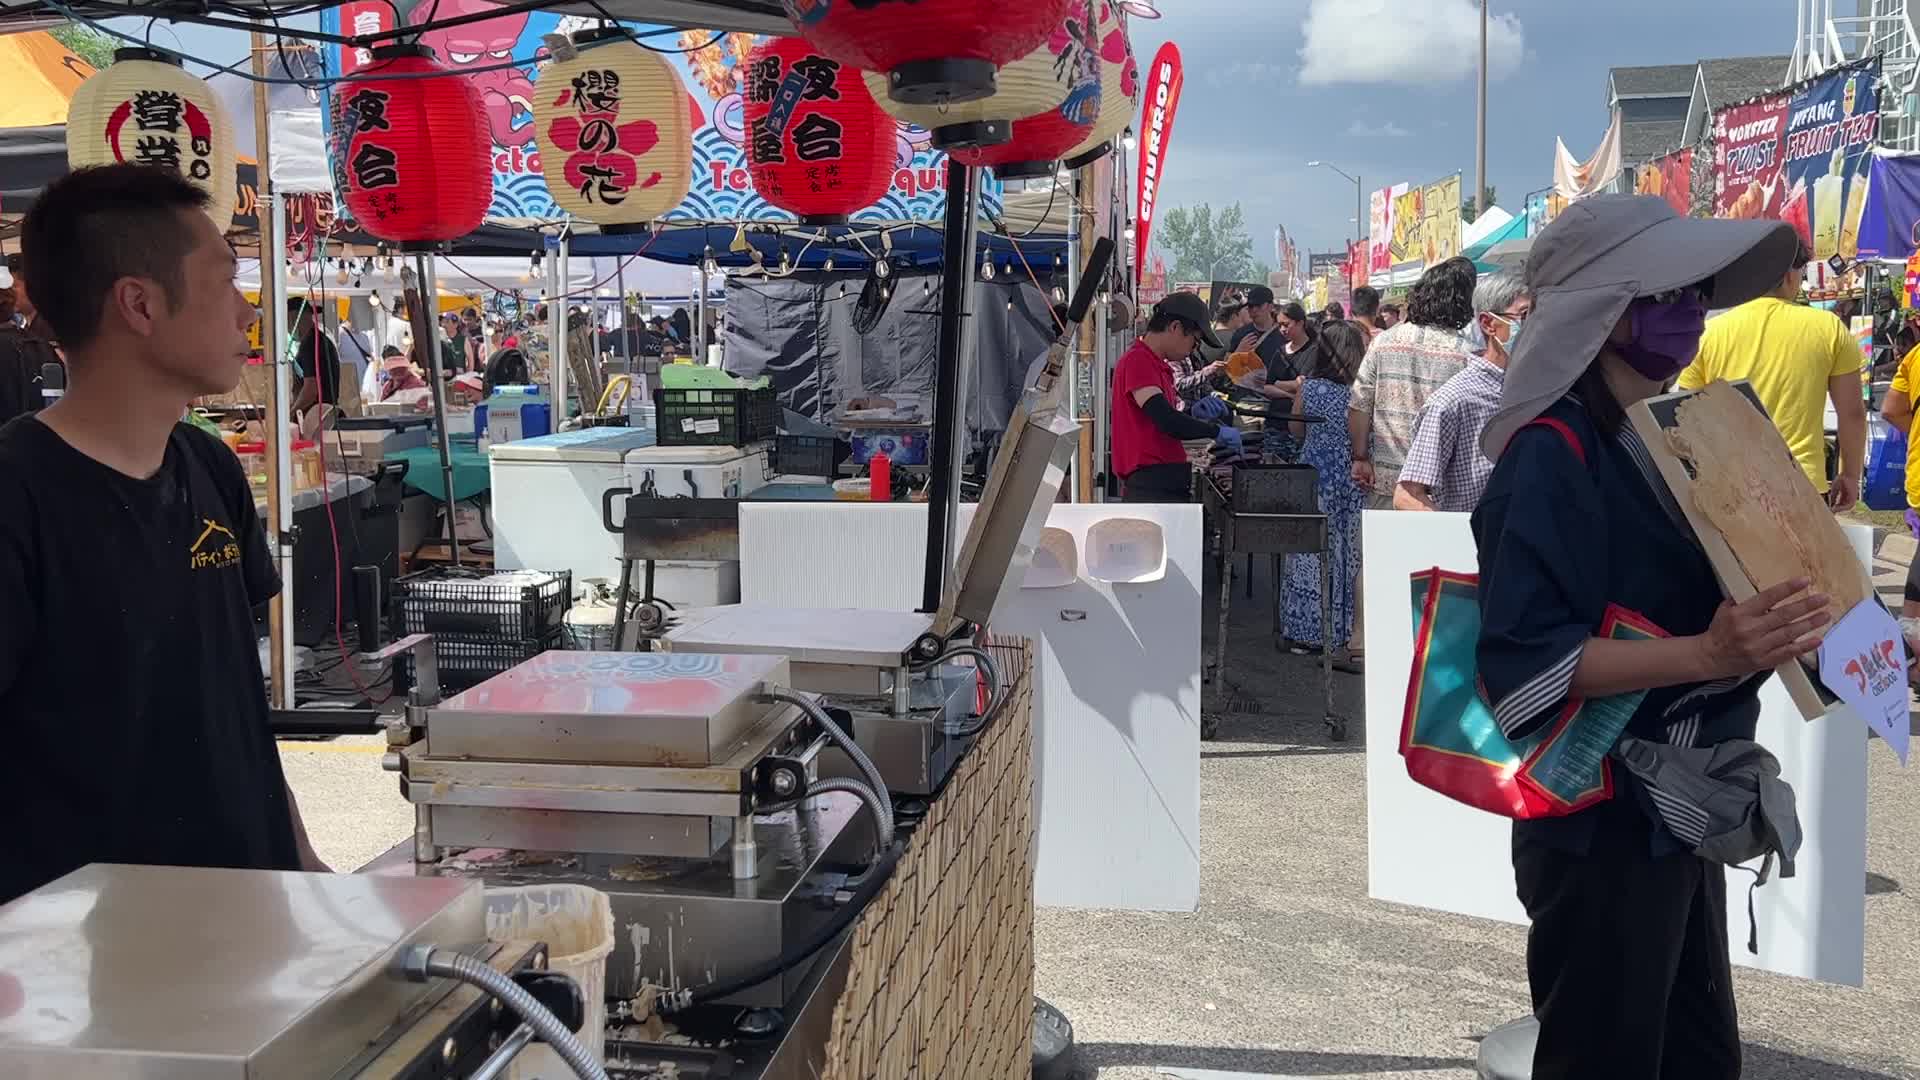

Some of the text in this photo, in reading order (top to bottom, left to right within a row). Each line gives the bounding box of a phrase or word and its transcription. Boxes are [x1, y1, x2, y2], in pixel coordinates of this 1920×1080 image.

[1140, 61, 1173, 223] CHURROS
[1785, 111, 1878, 162] FRUIT TEA
